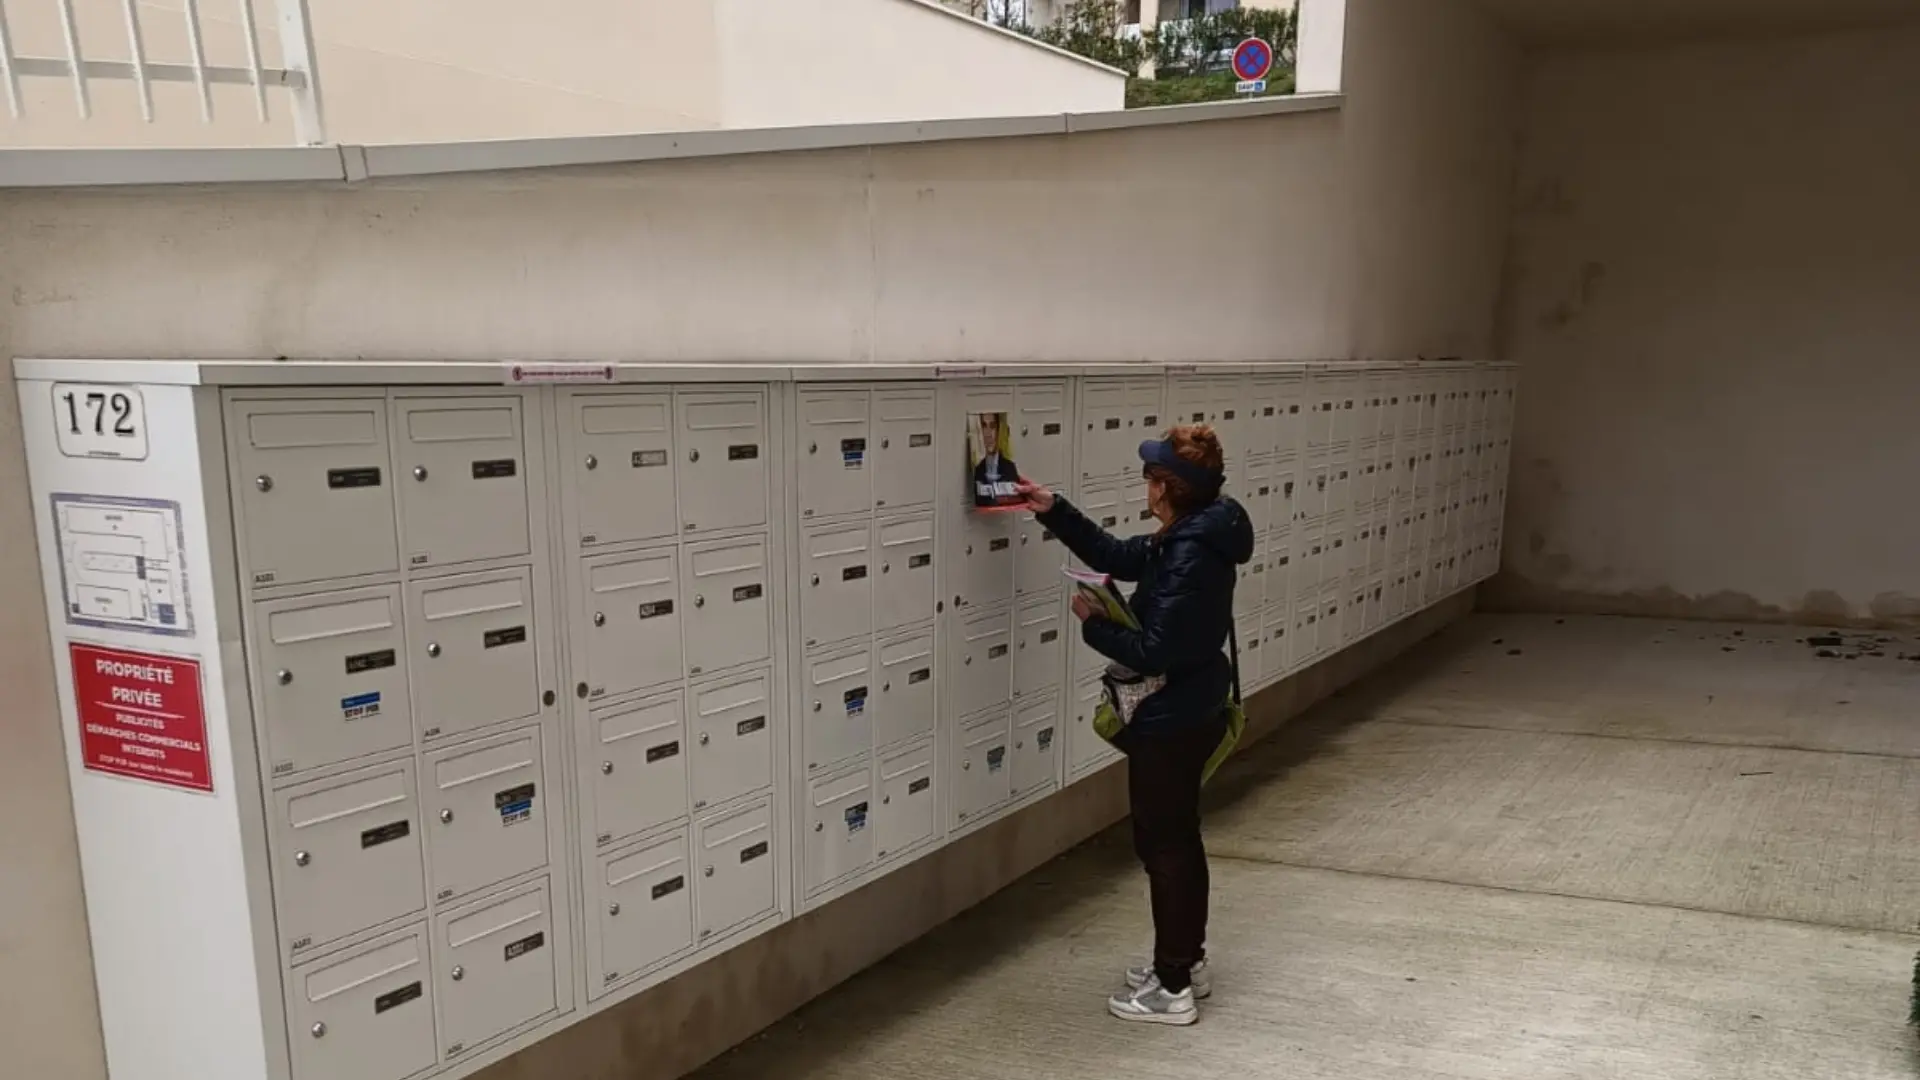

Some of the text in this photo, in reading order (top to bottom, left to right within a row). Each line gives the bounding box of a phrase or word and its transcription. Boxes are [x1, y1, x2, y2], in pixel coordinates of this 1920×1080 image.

[62, 391, 136, 437] 172
[95, 658, 174, 684] PROPRIÉTÉ
[111, 686, 163, 708] PRIVÉE
